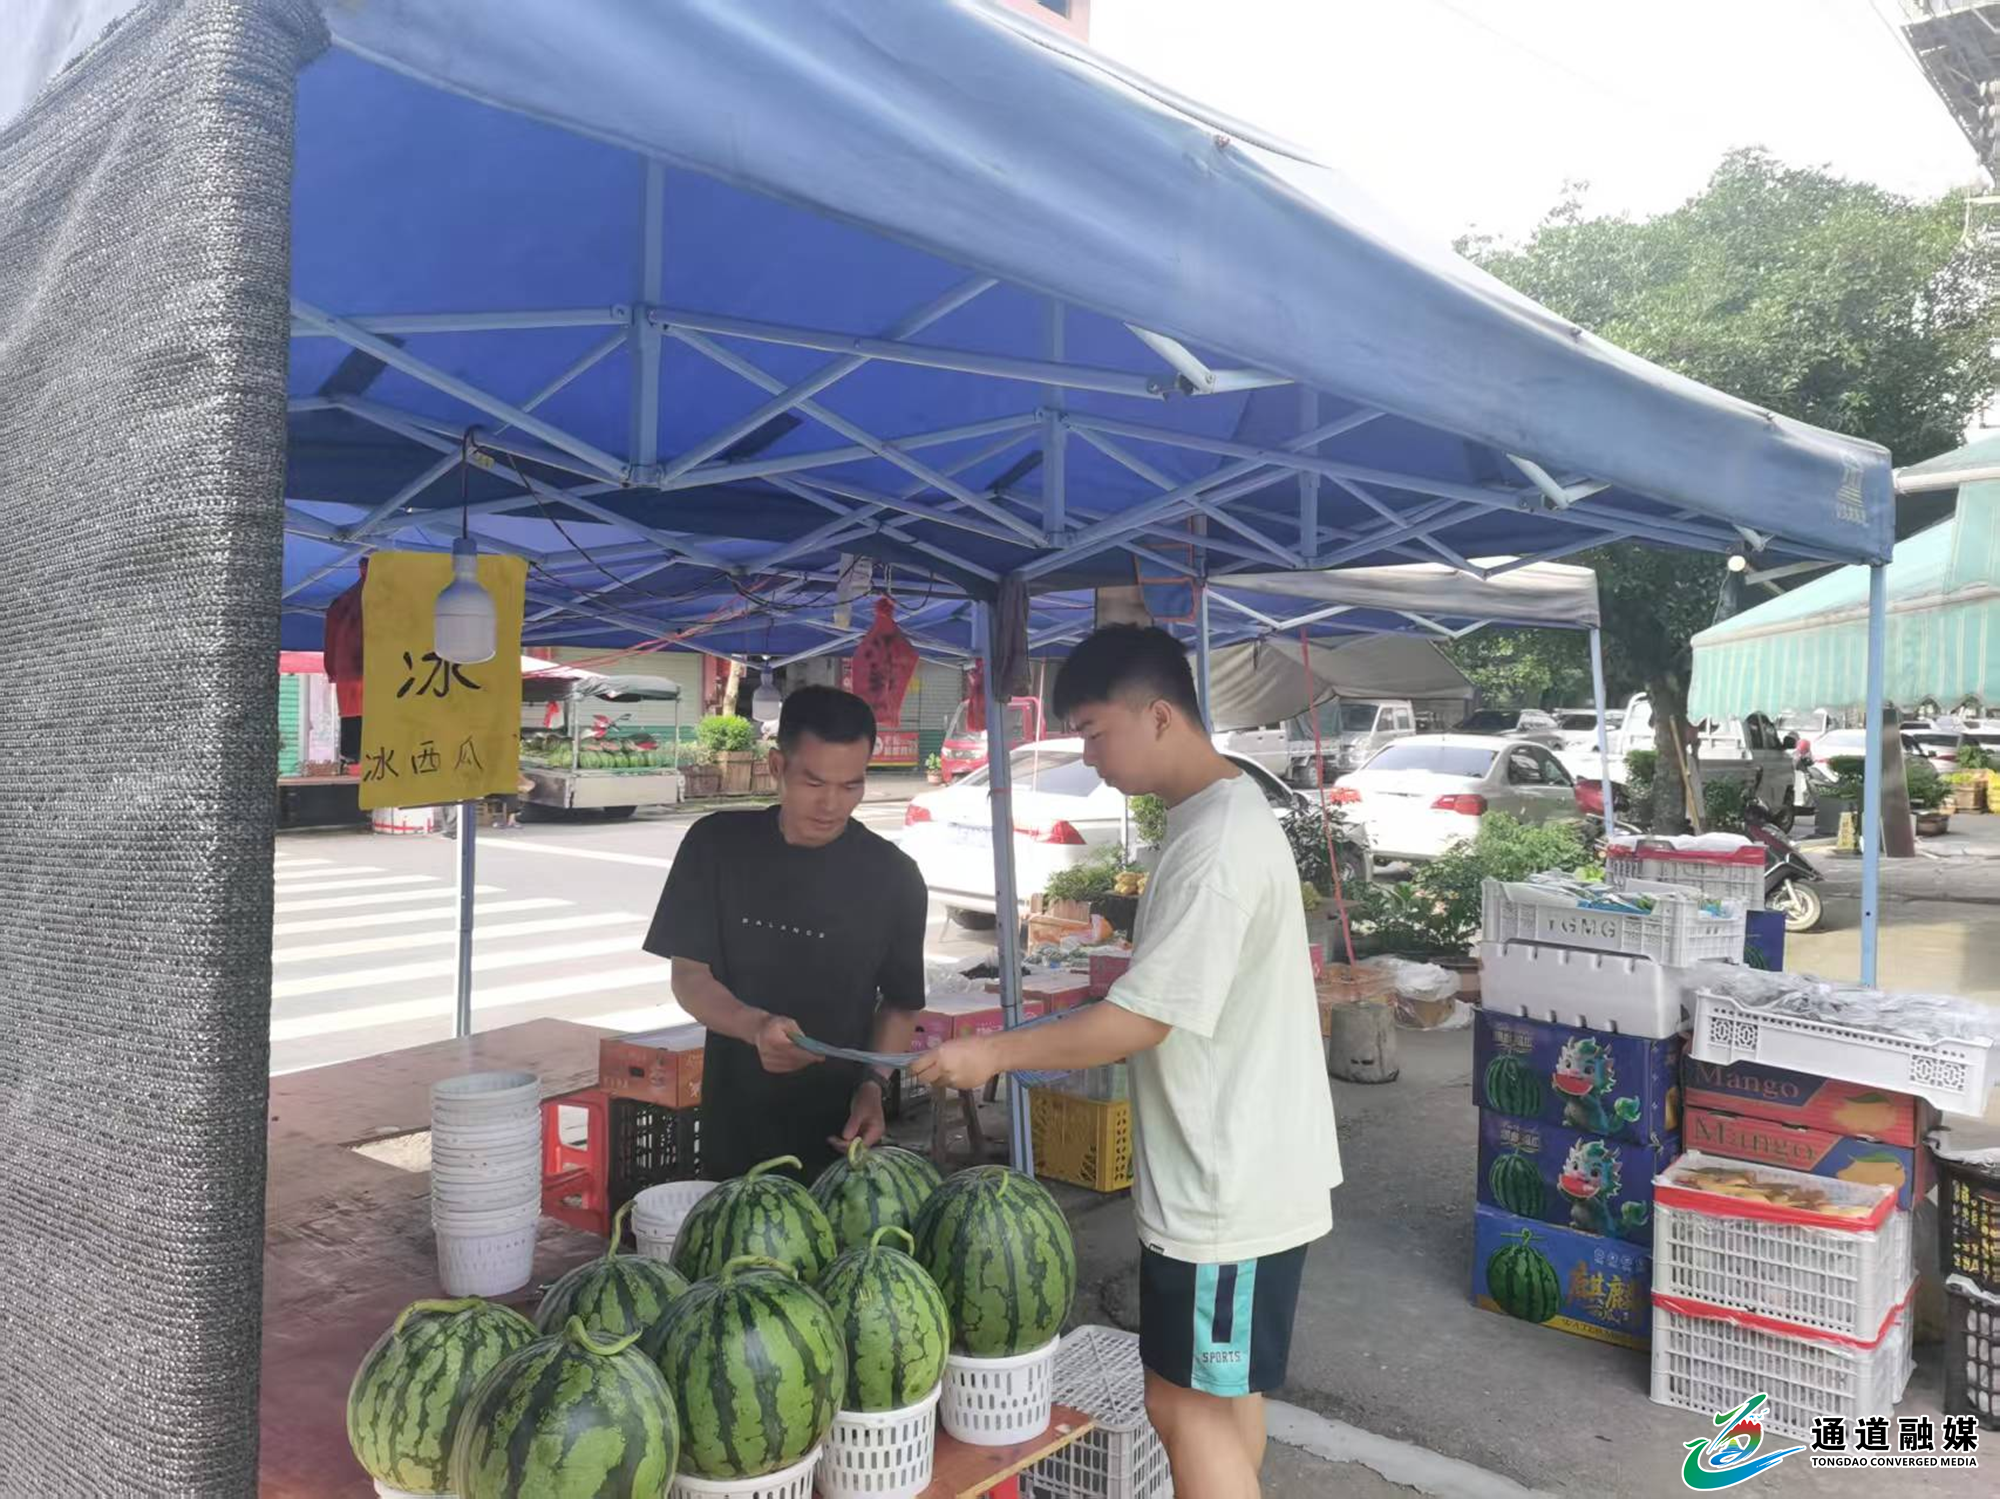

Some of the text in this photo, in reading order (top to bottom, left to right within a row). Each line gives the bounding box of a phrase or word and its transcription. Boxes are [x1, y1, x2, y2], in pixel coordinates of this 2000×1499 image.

[396, 651, 482, 698] 冰
[363, 735, 484, 782] 冰西瓜
[1697, 1063, 1800, 1099] Mango
[1694, 1117, 1817, 1162] Mango
[1202, 1350, 1241, 1364] SPORTS
